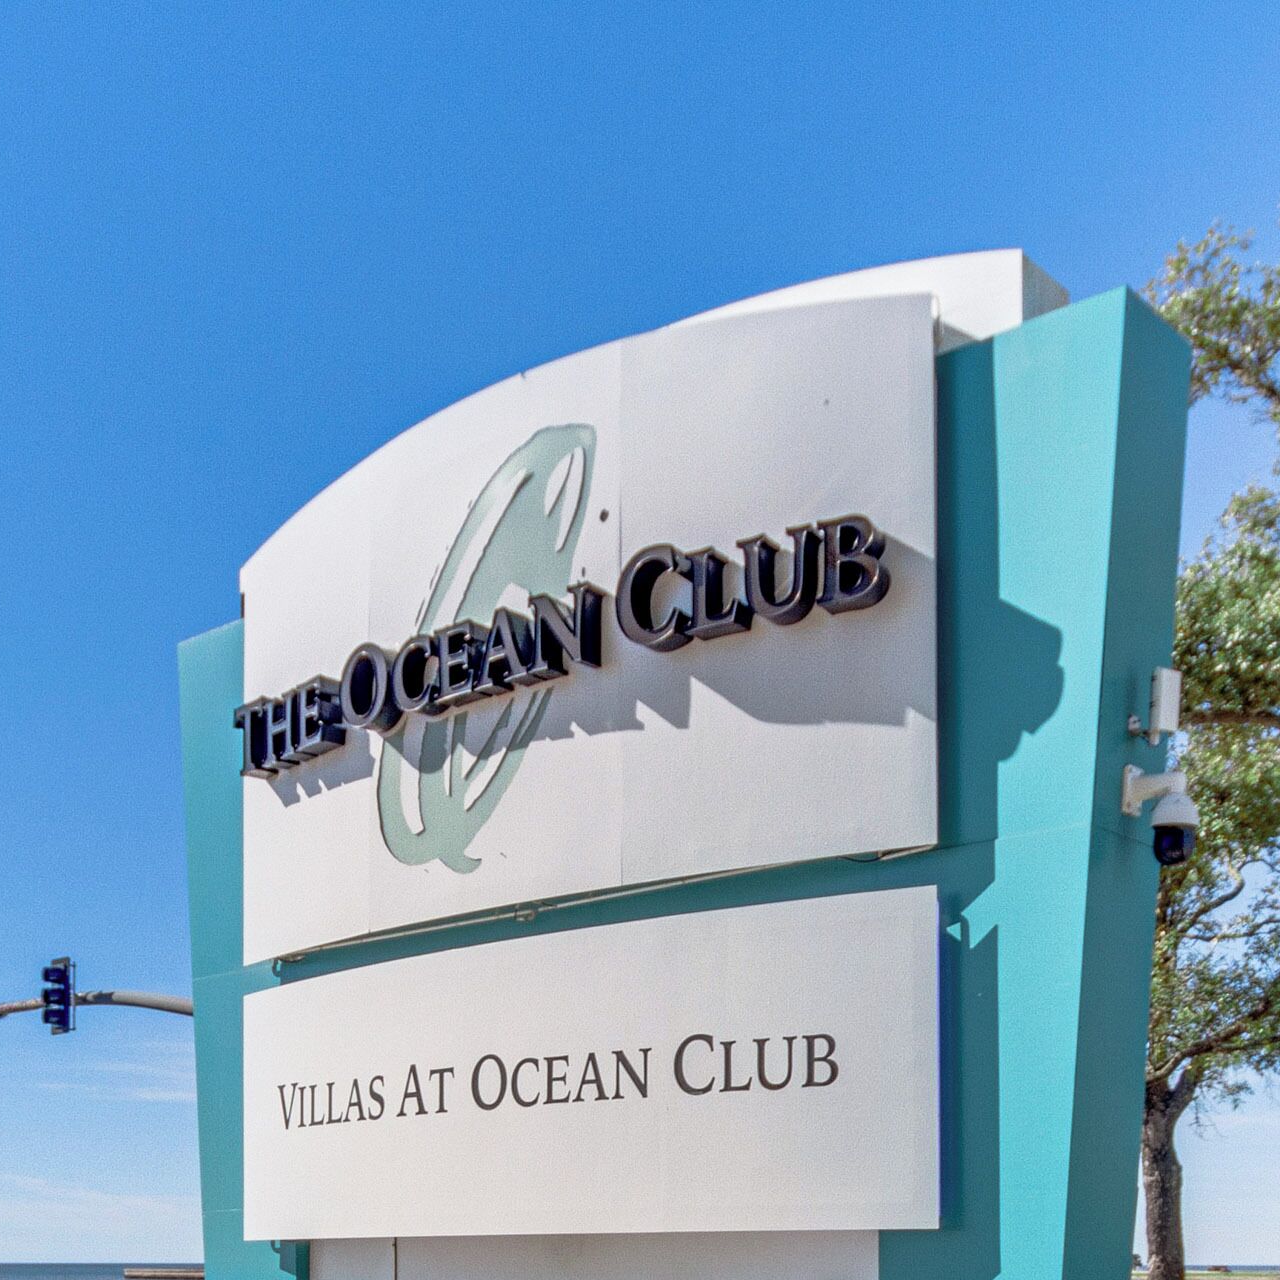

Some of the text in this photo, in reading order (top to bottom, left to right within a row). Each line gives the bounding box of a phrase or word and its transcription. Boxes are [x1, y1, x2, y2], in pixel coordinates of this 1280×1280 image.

[234, 514, 891, 778] THE OCEAN CLUB
[277, 1032, 840, 1130] VILLAS AT OCEAN CLUB
